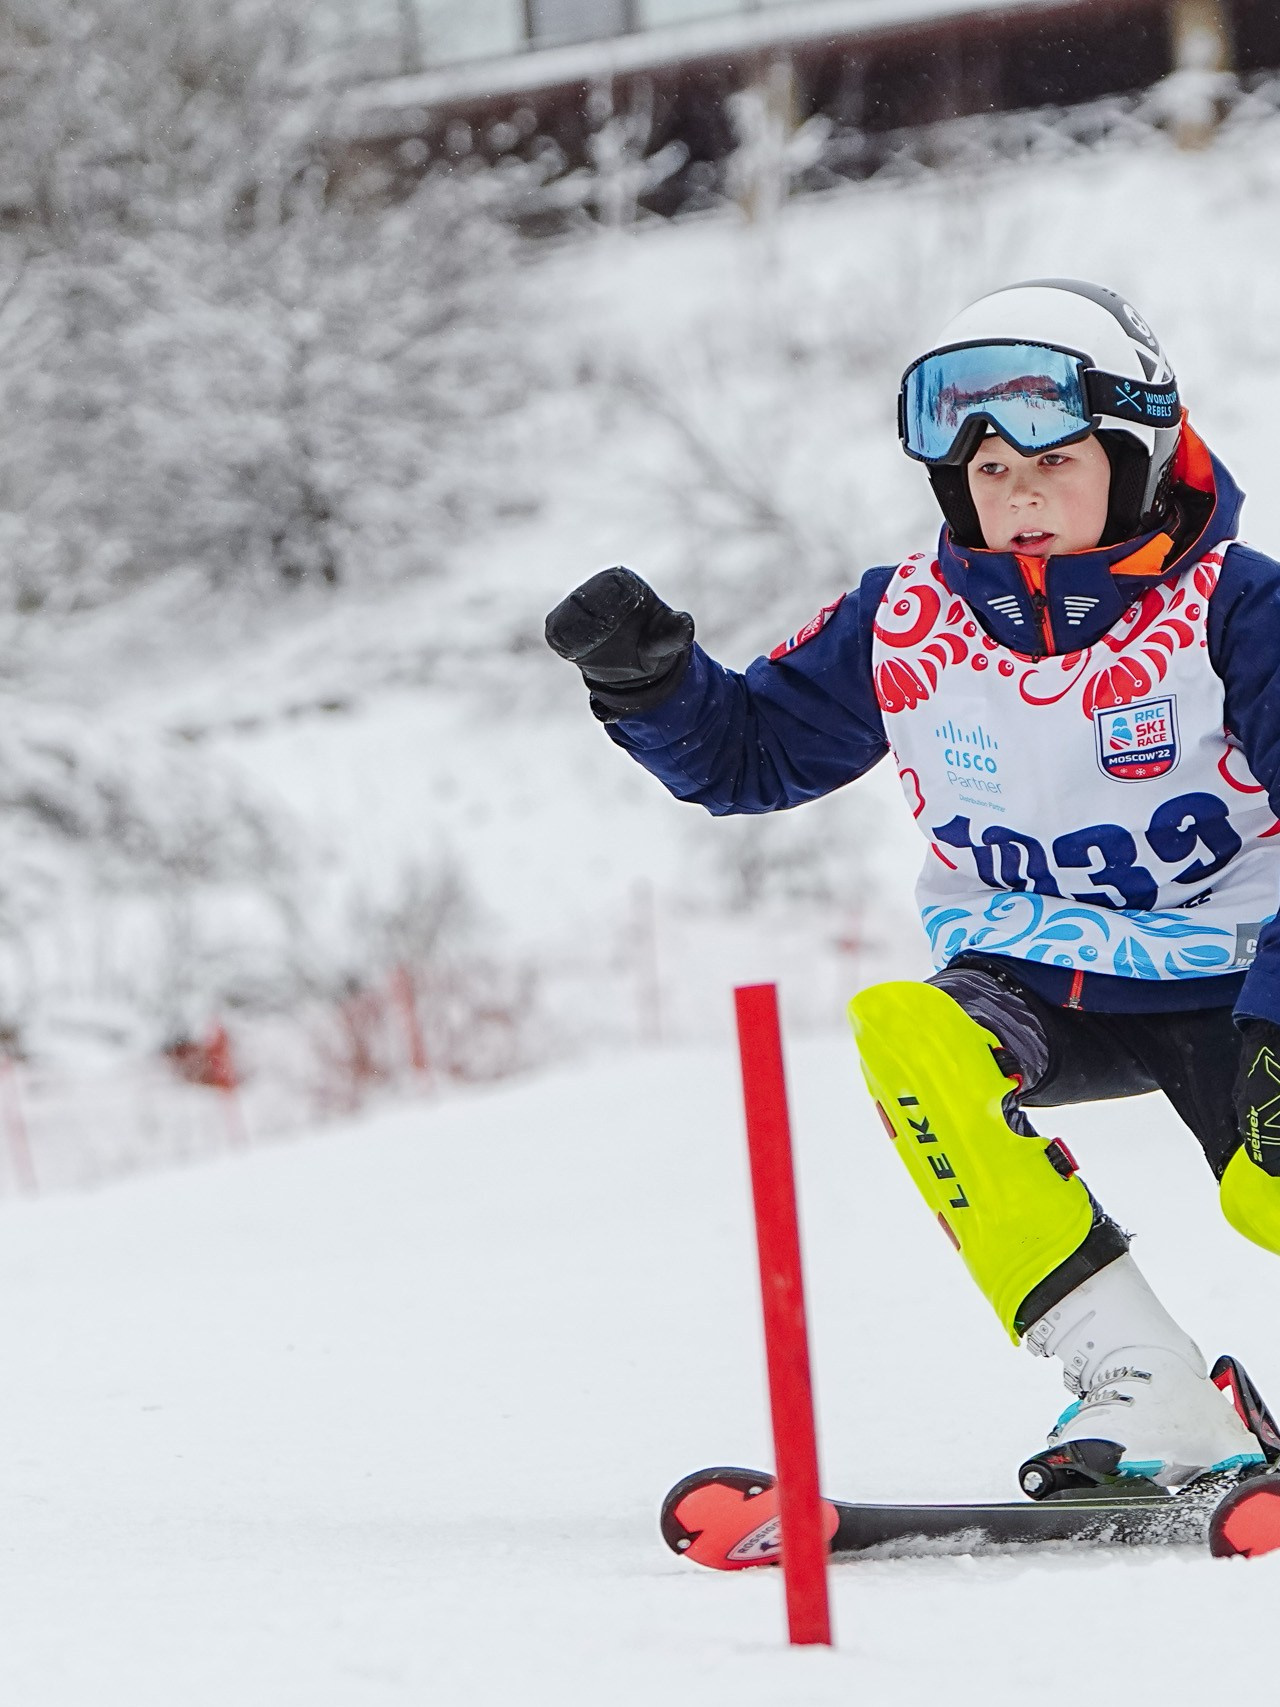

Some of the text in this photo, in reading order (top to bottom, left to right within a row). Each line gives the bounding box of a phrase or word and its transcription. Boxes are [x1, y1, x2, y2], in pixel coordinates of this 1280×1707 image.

[1146, 404, 1172, 416] REBELS
[1135, 707, 1165, 723] RRC
[1135, 719, 1166, 737] SKI
[1137, 732, 1167, 747] RACE
[946, 770, 1002, 794] Partner
[932, 792, 1242, 911] 1039
[898, 1096, 970, 1208] LEKI
